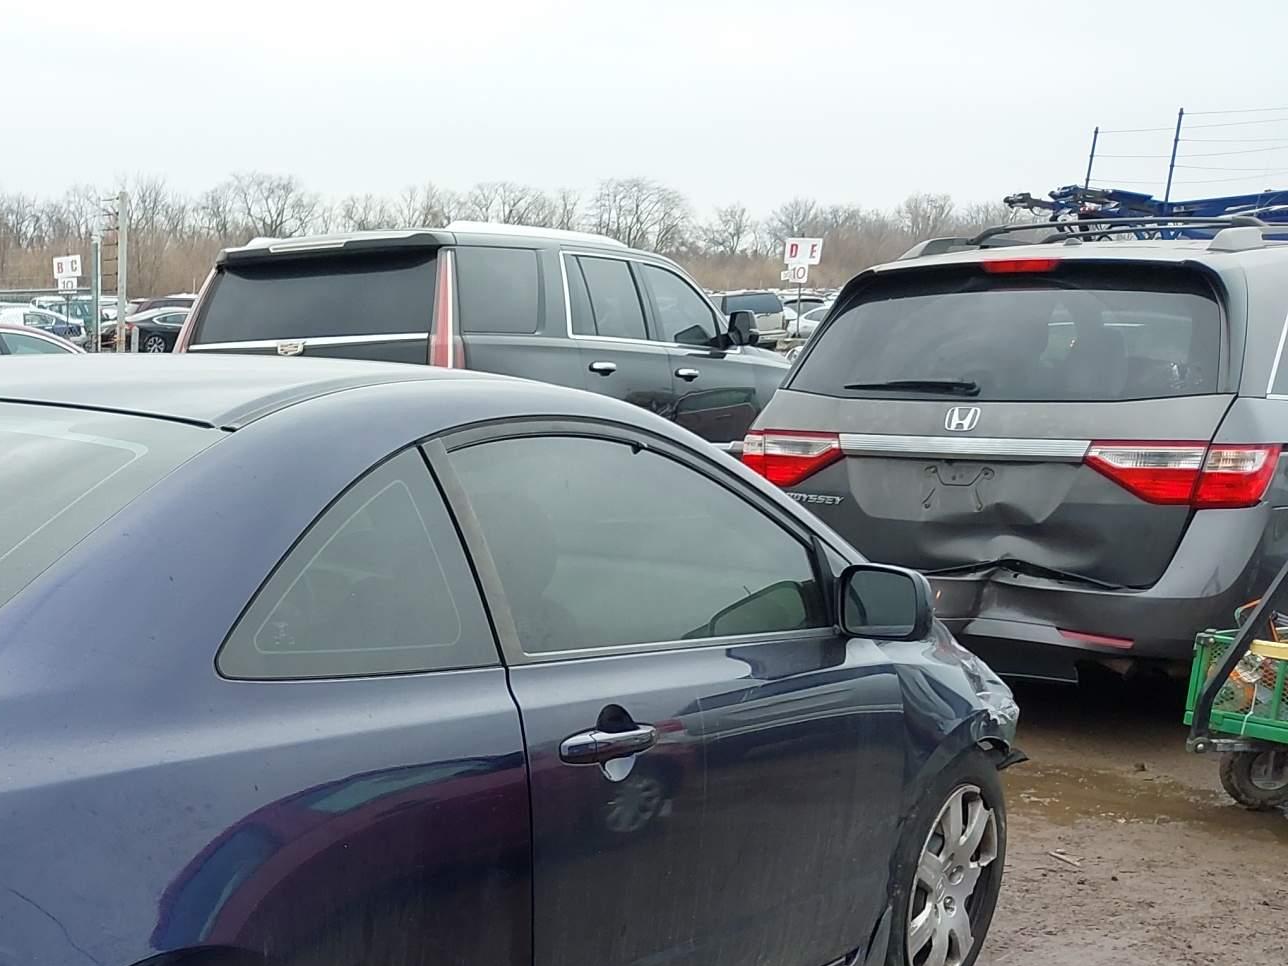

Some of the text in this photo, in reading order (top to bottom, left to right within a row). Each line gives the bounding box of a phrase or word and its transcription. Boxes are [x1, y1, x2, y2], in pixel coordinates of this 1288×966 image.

[789, 243, 818, 259] D E
[70, 259, 78, 272] C
[792, 266, 806, 280] 10
